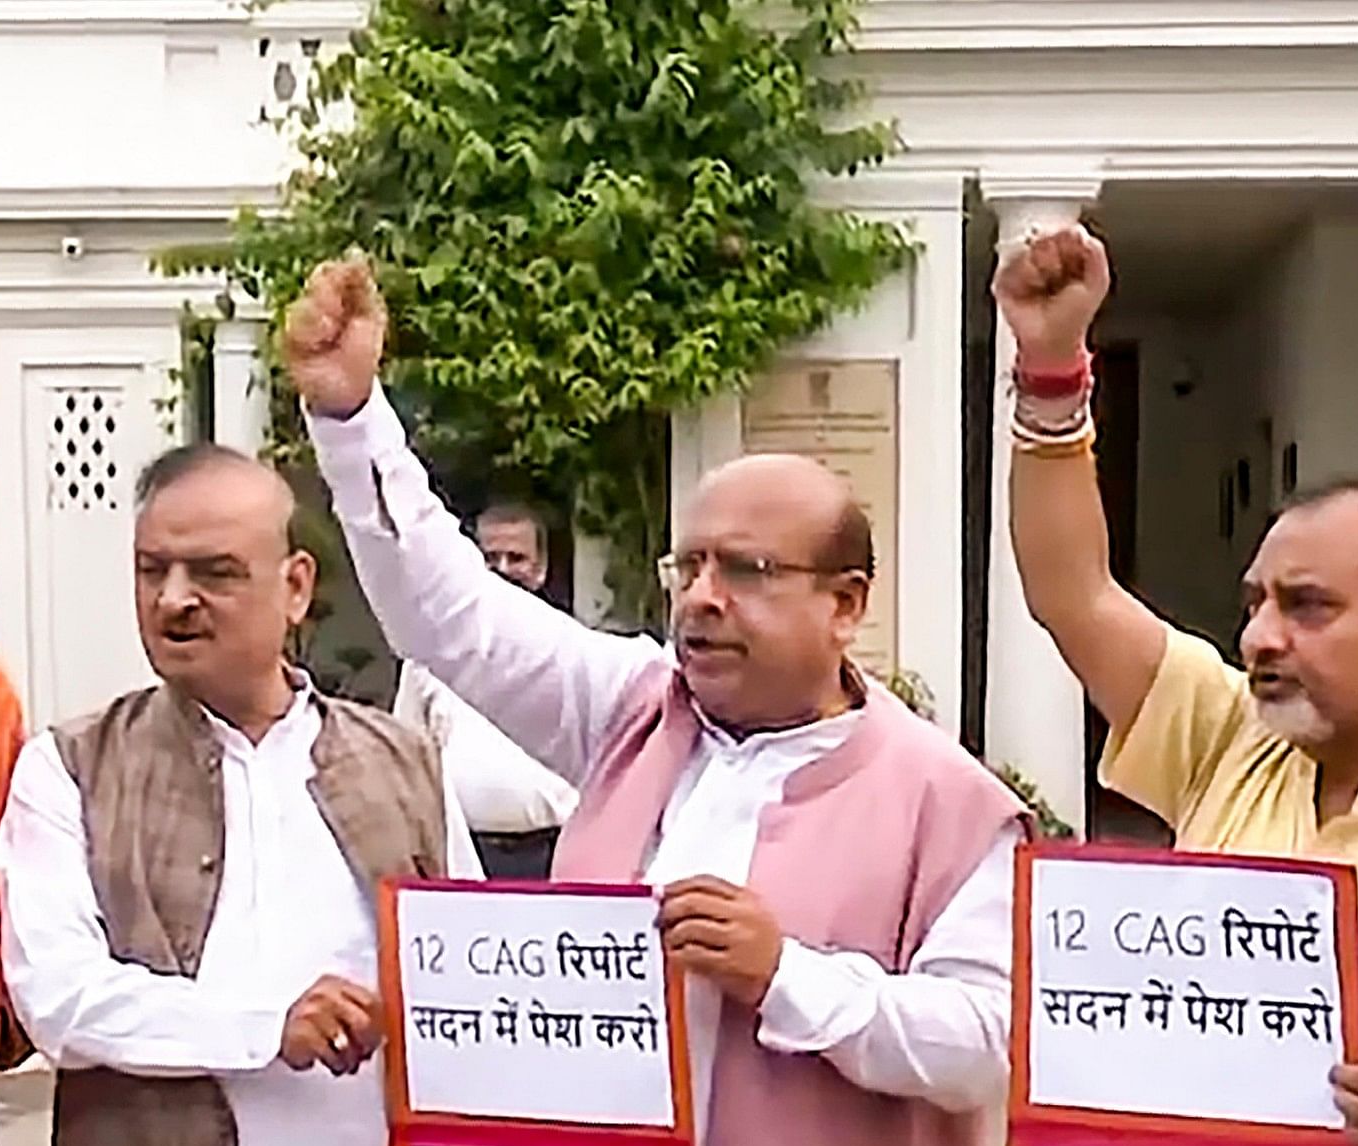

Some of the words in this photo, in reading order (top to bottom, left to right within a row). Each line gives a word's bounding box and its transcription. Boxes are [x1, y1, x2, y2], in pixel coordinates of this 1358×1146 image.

[410, 933, 445, 975] 12
[467, 935, 546, 978] CAG
[556, 930, 650, 981] रिपोर्ट
[1046, 908, 1089, 952] 12
[1113, 911, 1207, 958] CAG
[1220, 906, 1321, 964] रिपोर्ट
[410, 1005, 483, 1047] सदन
[491, 996, 519, 1046] में
[527, 998, 584, 1048] पेश
[590, 1005, 659, 1053] करो
[1039, 987, 1133, 1032] सदन
[1140, 978, 1174, 1031] में
[1181, 980, 1250, 1037] पेश
[1257, 987, 1335, 1045] करो
